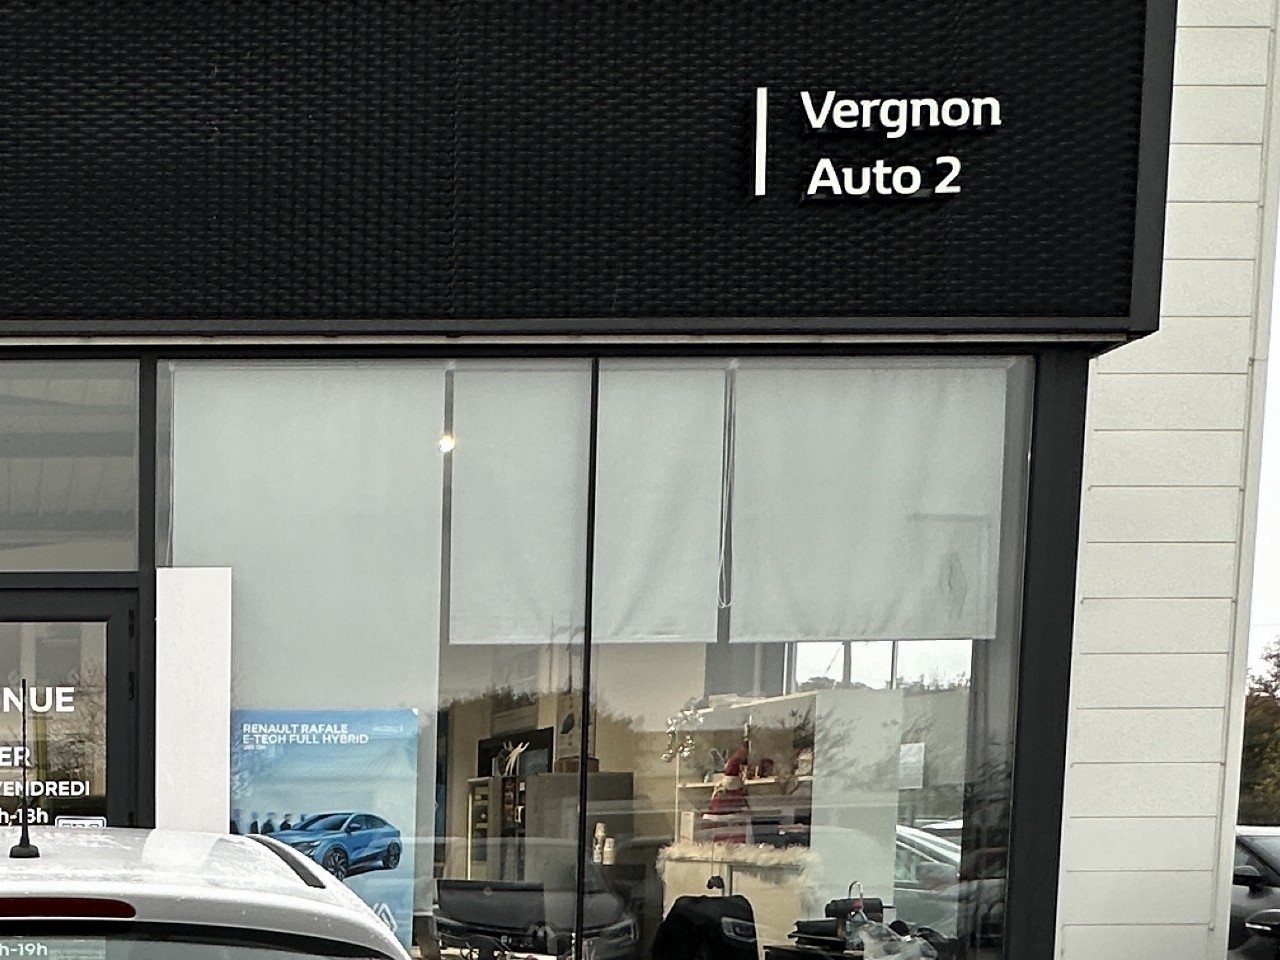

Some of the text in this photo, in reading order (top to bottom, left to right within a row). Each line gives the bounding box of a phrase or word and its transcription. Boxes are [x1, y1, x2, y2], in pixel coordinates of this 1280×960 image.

[800, 90, 1002, 138] Vergnon
[807, 156, 962, 195] Auto 2
[243, 724, 348, 734] RENAULT RAFALE
[243, 734, 369, 744] E-TECH FULL HYBRID
